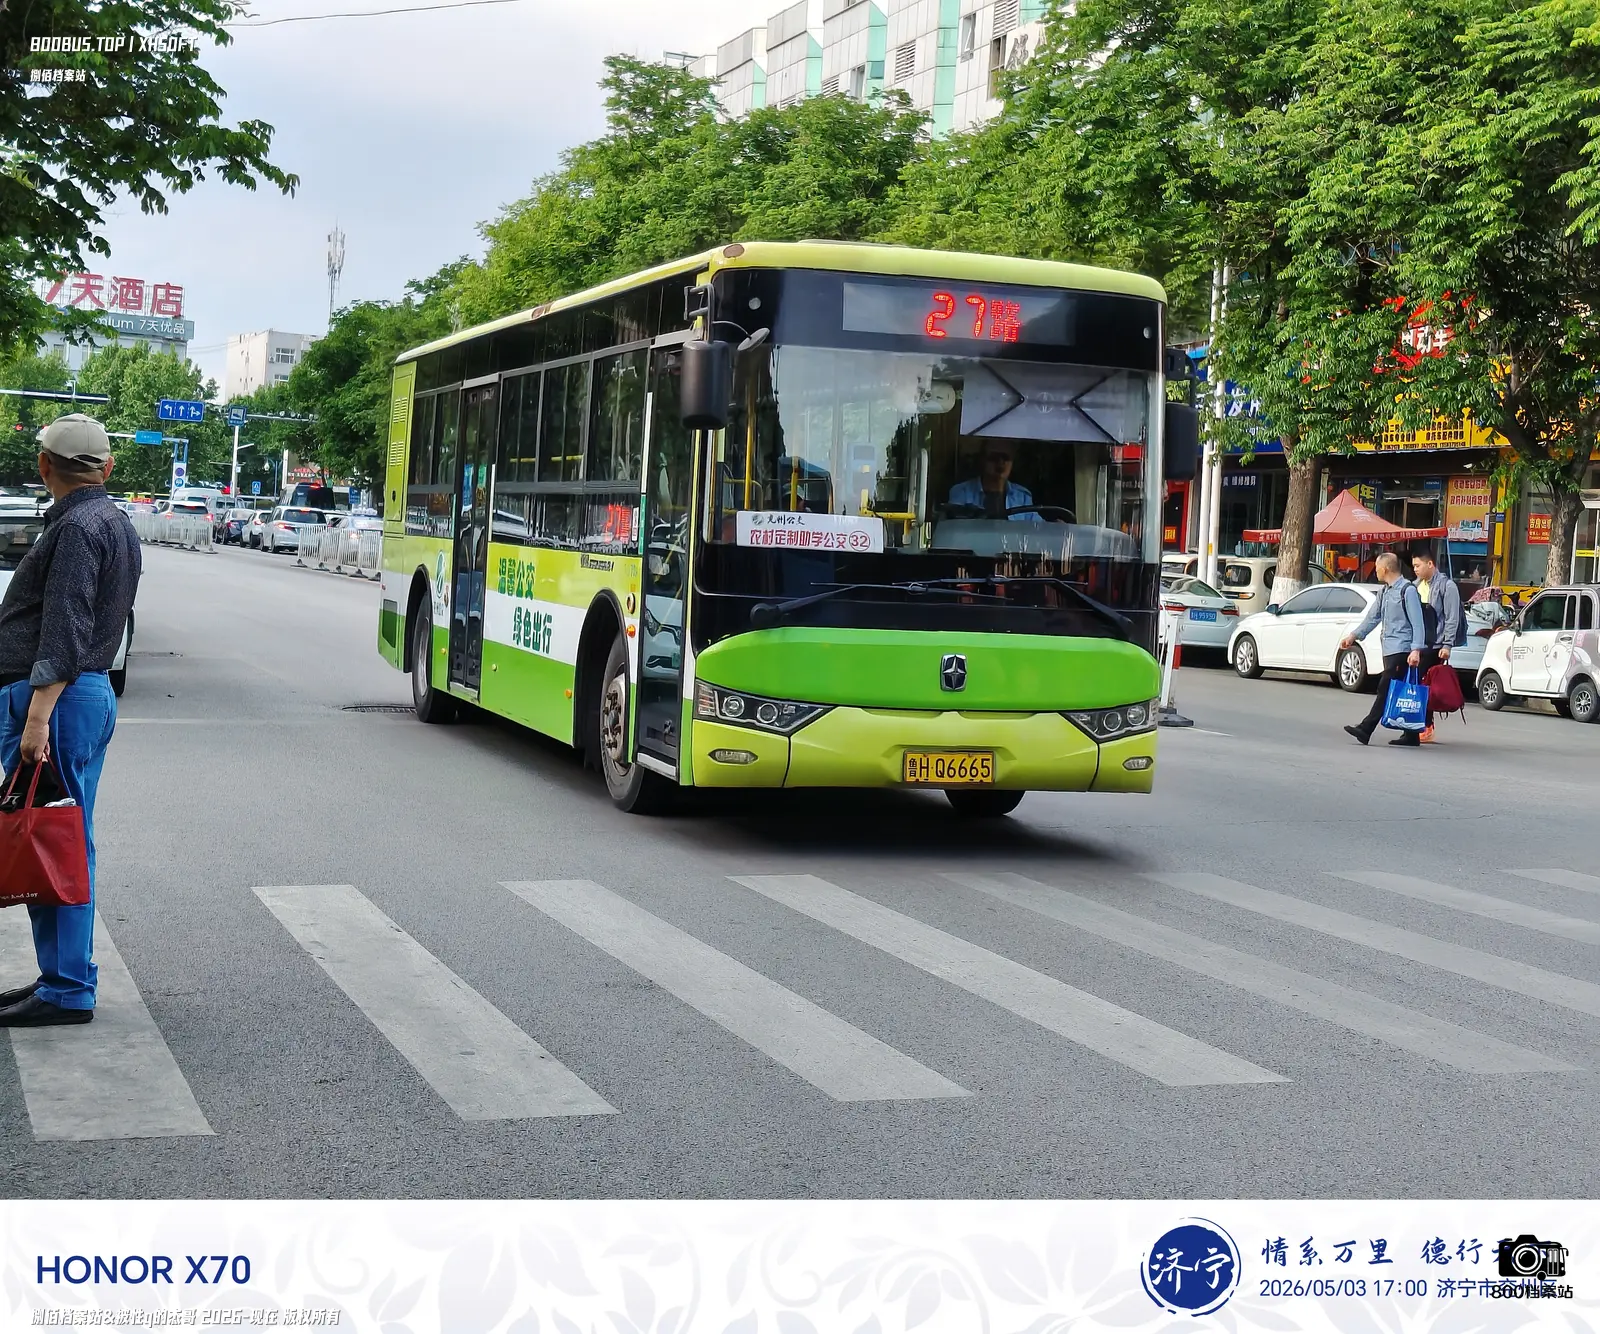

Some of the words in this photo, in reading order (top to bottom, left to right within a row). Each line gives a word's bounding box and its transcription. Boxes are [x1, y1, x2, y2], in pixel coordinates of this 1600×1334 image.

[926, 293, 1021, 343] 27路
[498, 557, 535, 600] 温馨公交
[513, 606, 552, 654] 绿色出行
